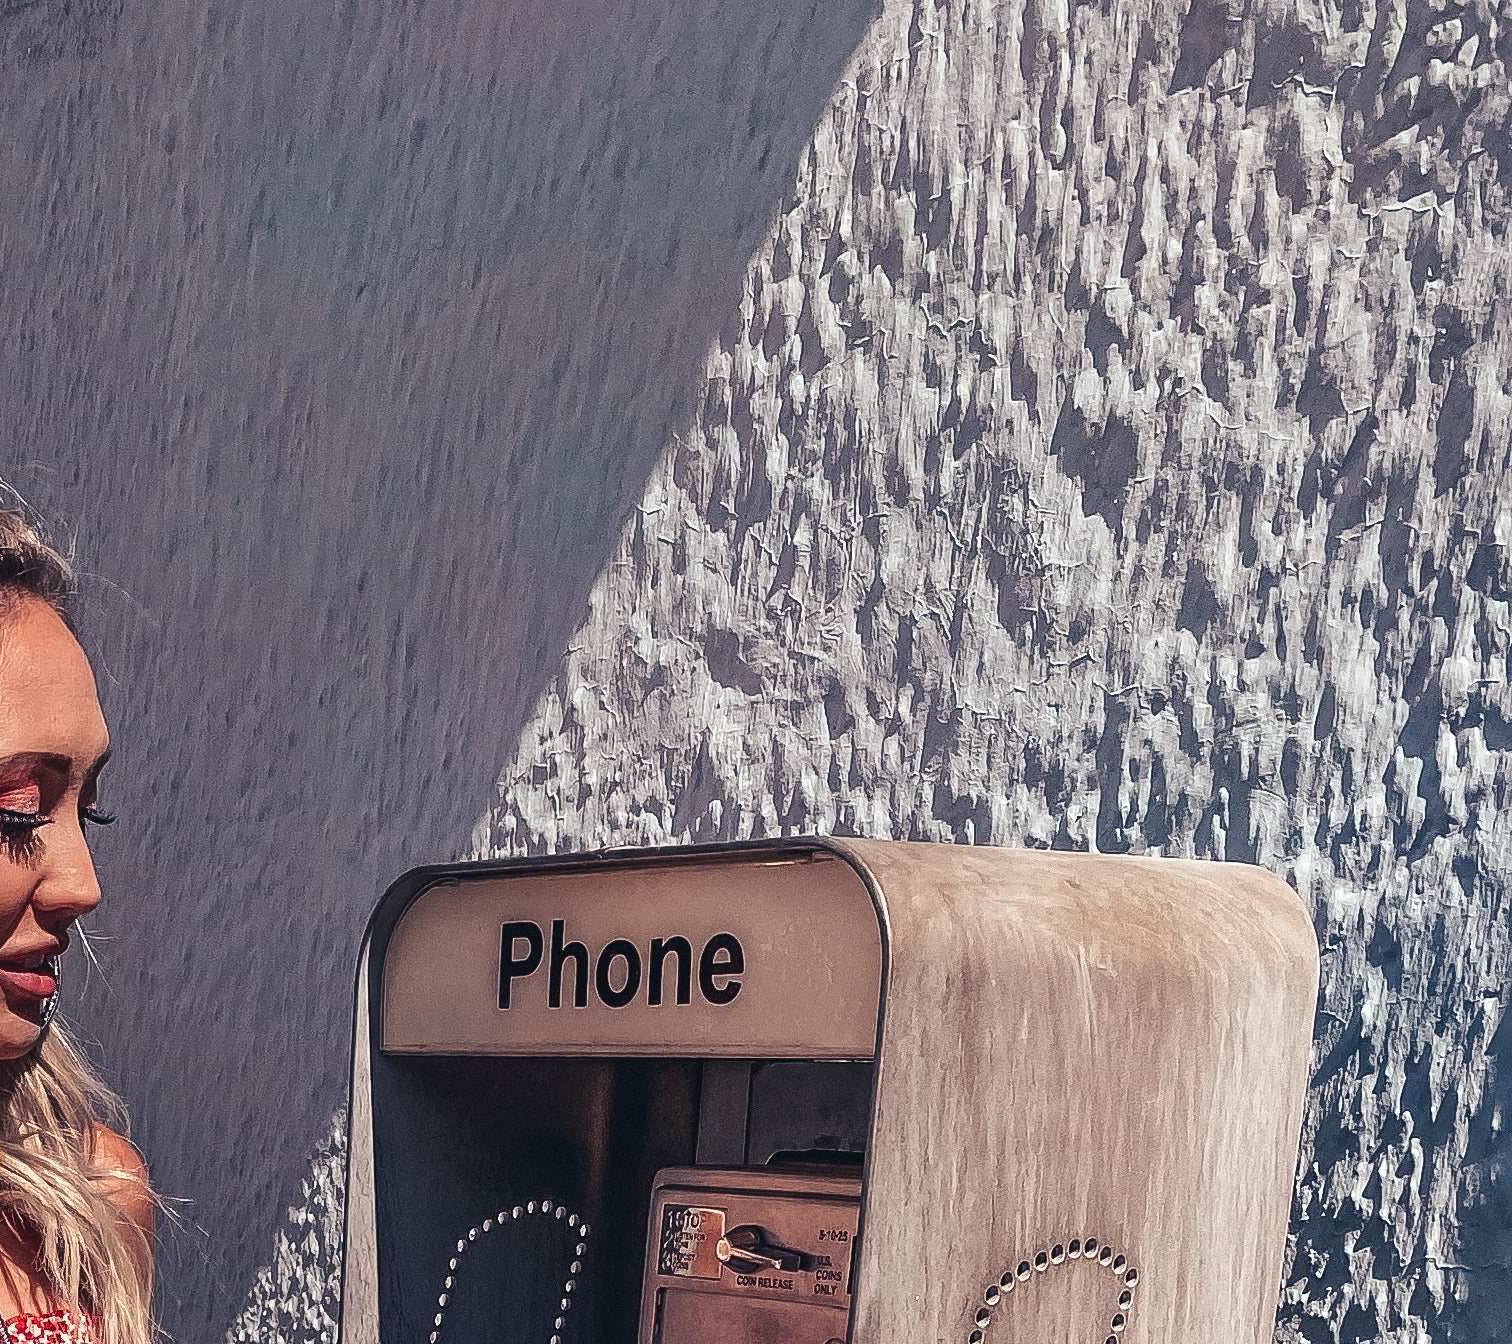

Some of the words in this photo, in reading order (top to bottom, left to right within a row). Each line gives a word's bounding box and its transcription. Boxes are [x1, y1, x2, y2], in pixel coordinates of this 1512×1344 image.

[497, 919, 745, 1010] Phone
[818, 1229, 848, 1242] 5-10-25
[817, 1256, 832, 1267] U.S.
[815, 1269, 842, 1281] COINS
[736, 1275, 756, 1287] COIN
[758, 1277, 793, 1290] RELEASE
[813, 1283, 838, 1295] ONLY
